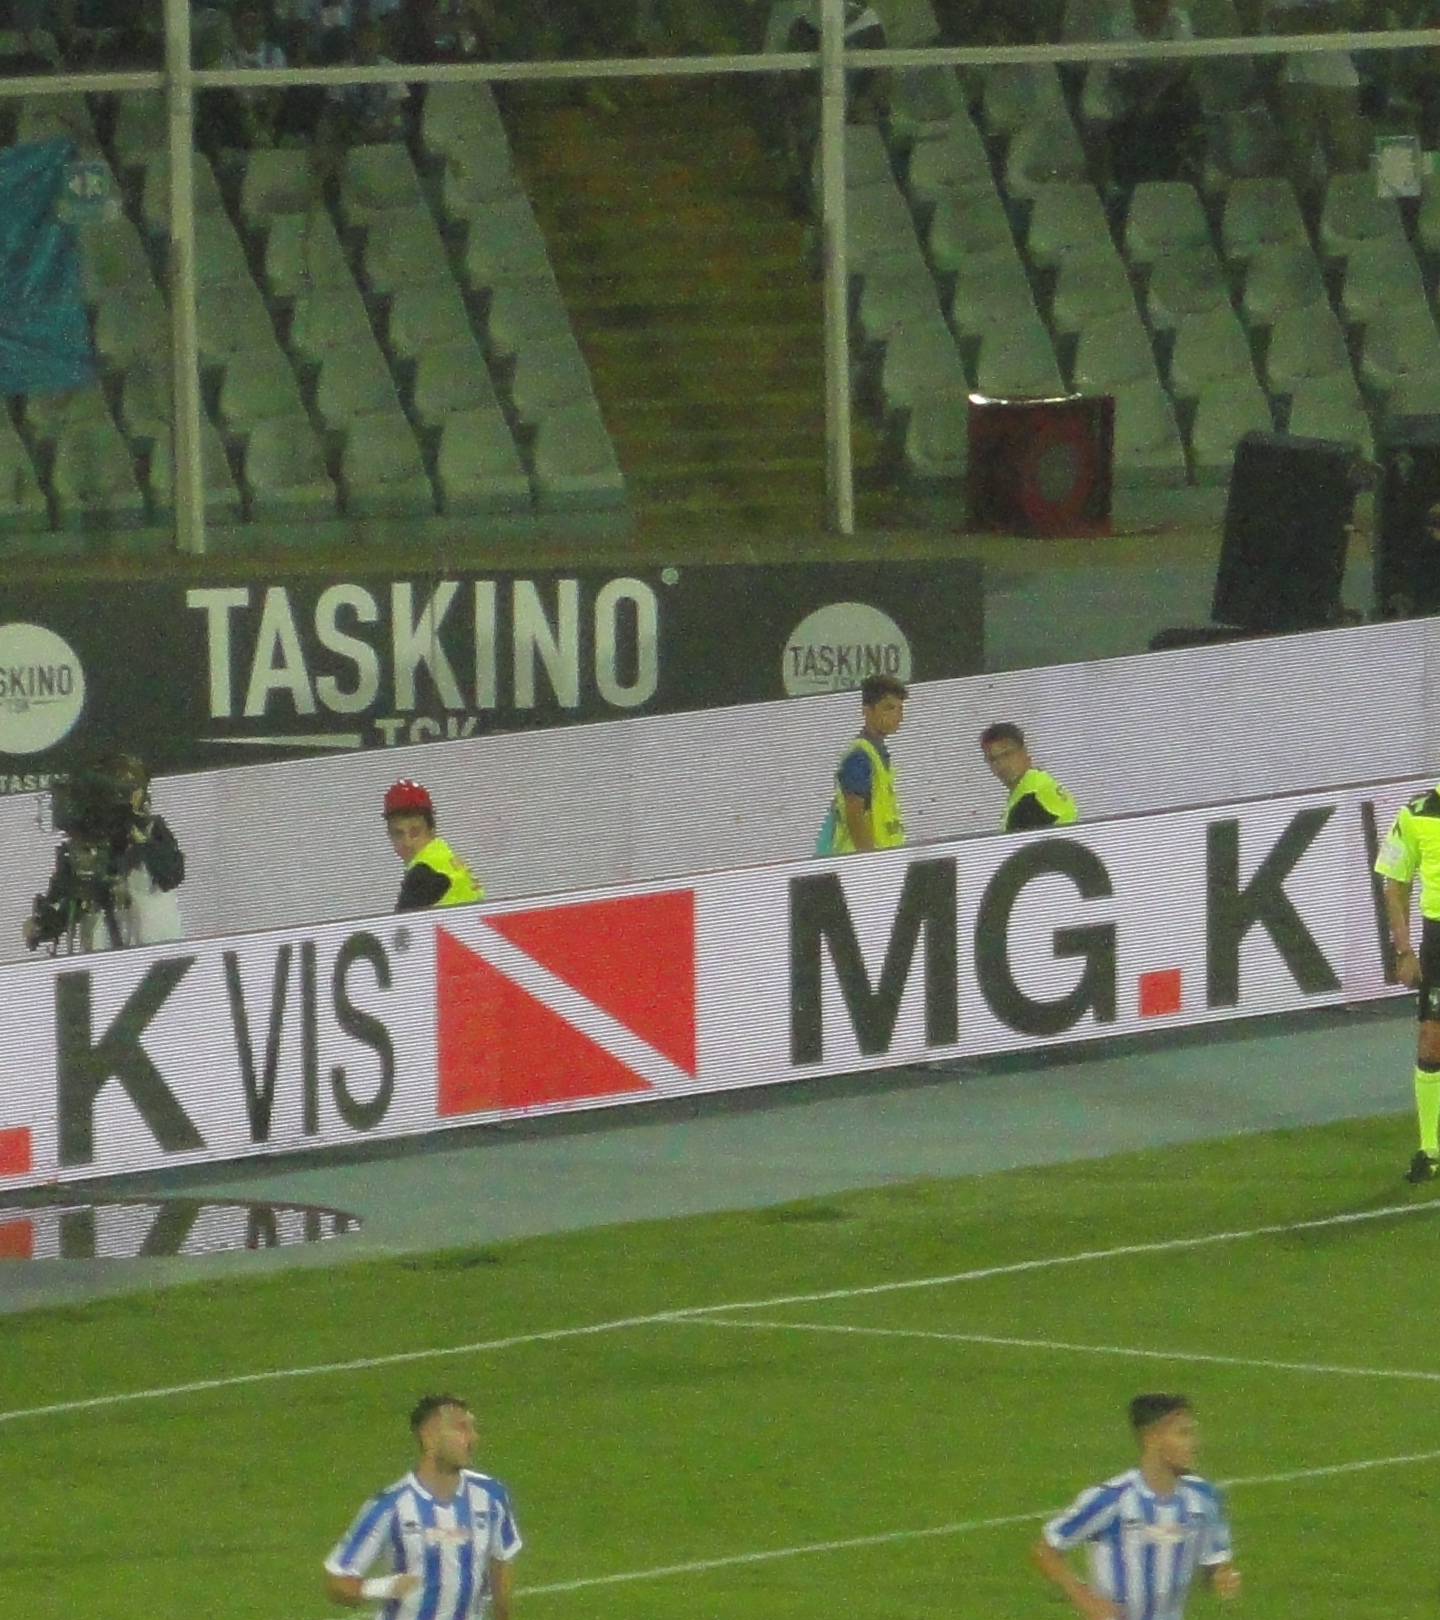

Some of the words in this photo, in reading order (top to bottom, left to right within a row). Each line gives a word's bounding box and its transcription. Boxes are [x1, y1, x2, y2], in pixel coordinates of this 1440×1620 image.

[187, 575, 659, 718] TASKINO
[789, 643, 900, 677] TASKINO
[789, 805, 1342, 1068] MG.K
[222, 930, 396, 1145] VIS
